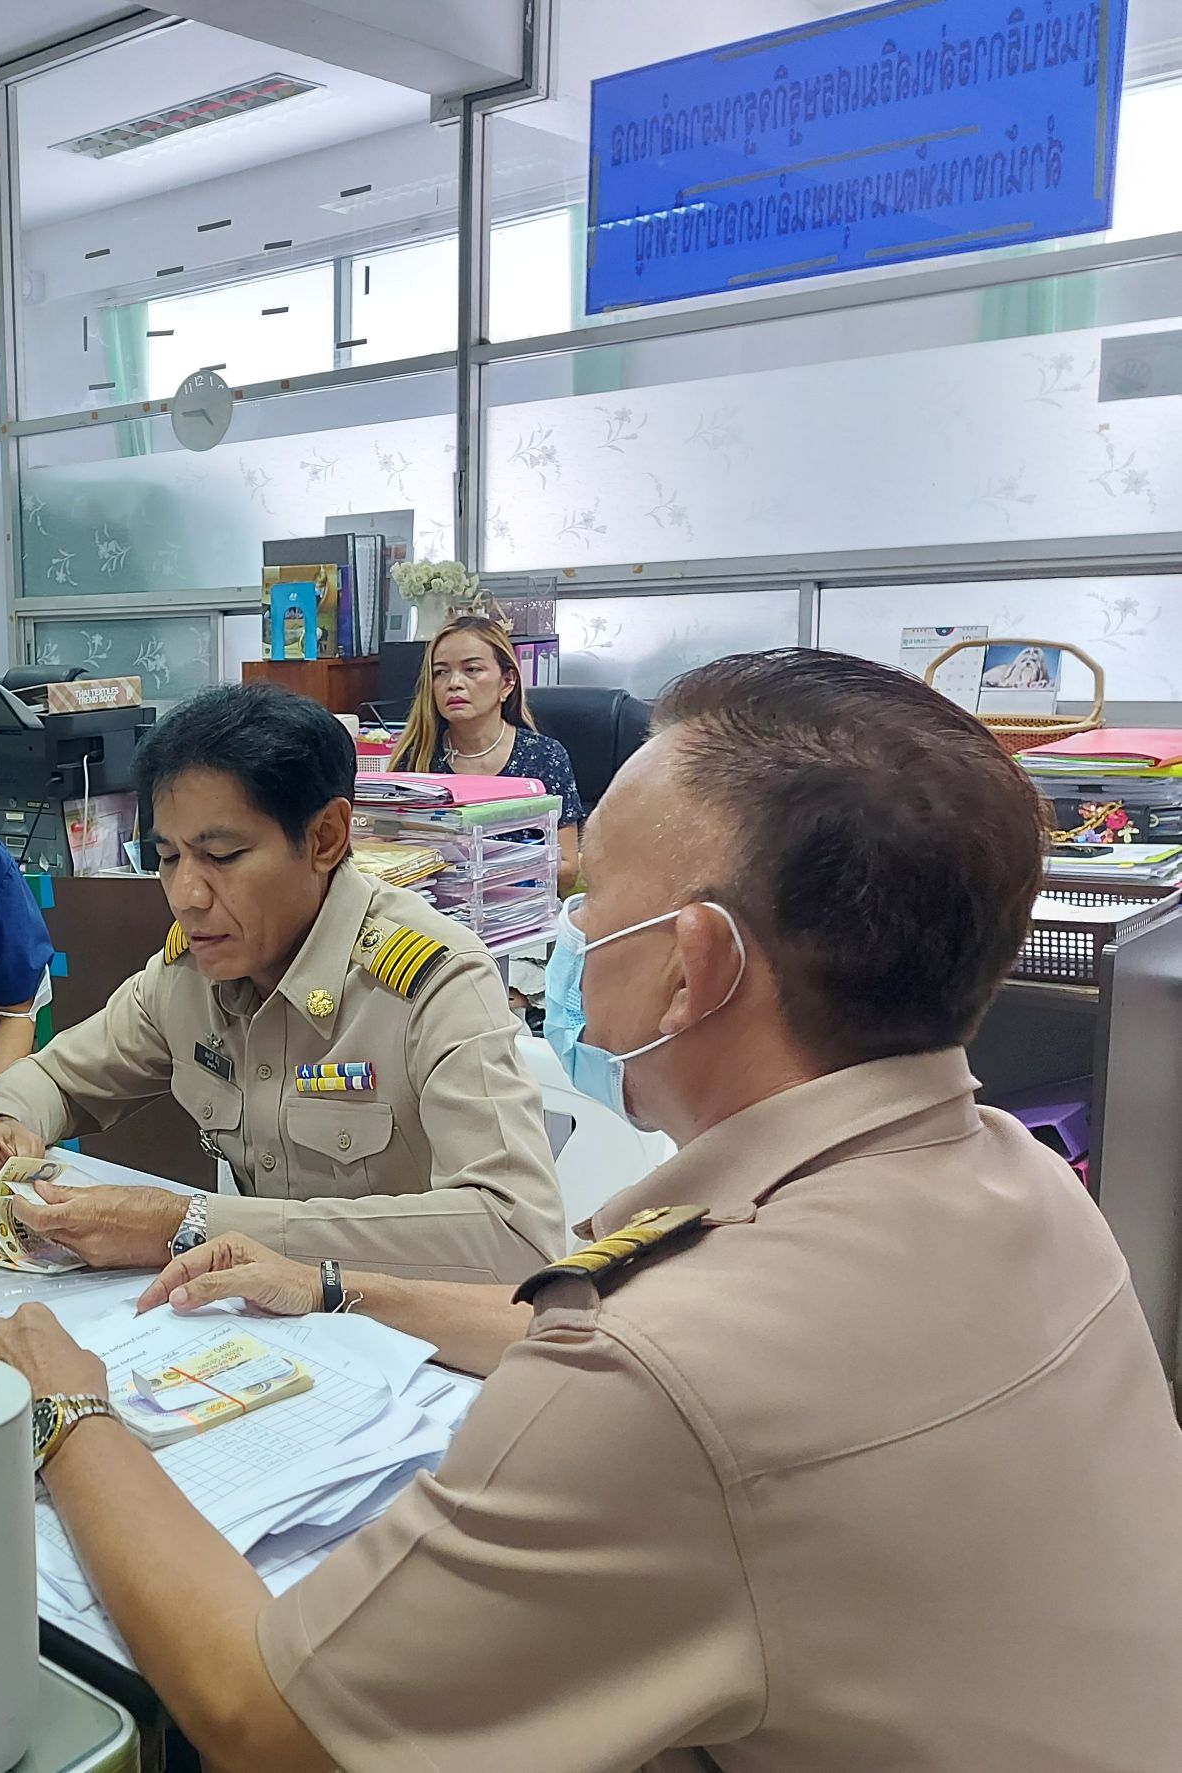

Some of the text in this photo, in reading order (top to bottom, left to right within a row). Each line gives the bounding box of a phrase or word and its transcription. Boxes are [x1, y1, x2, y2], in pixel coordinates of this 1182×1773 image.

[194, 375, 204, 386] 12
[74, 687, 119, 698] THAI TEXTILES
[77, 695, 117, 705] TREND BOOK
[351, 816, 367, 827] ne
